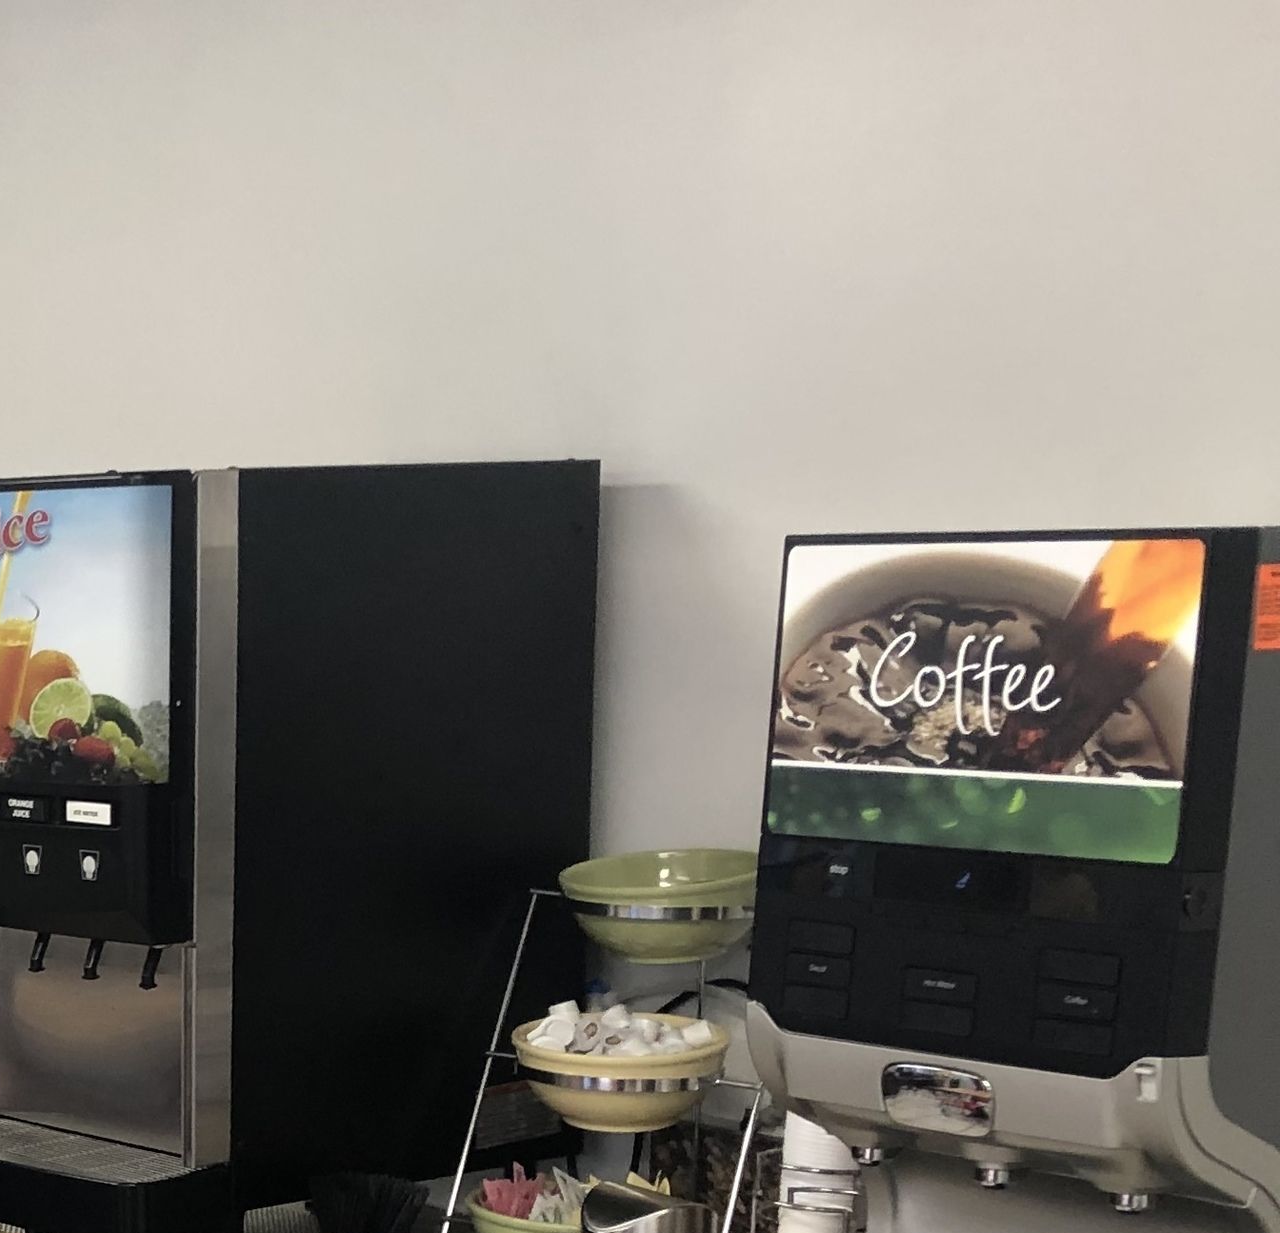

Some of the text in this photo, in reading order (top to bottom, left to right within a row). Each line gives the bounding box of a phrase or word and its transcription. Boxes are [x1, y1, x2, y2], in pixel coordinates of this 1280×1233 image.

[870, 631, 1062, 737] Coffee
[8, 798, 34, 809] ORANGE
[12, 809, 31, 819] JUICE
